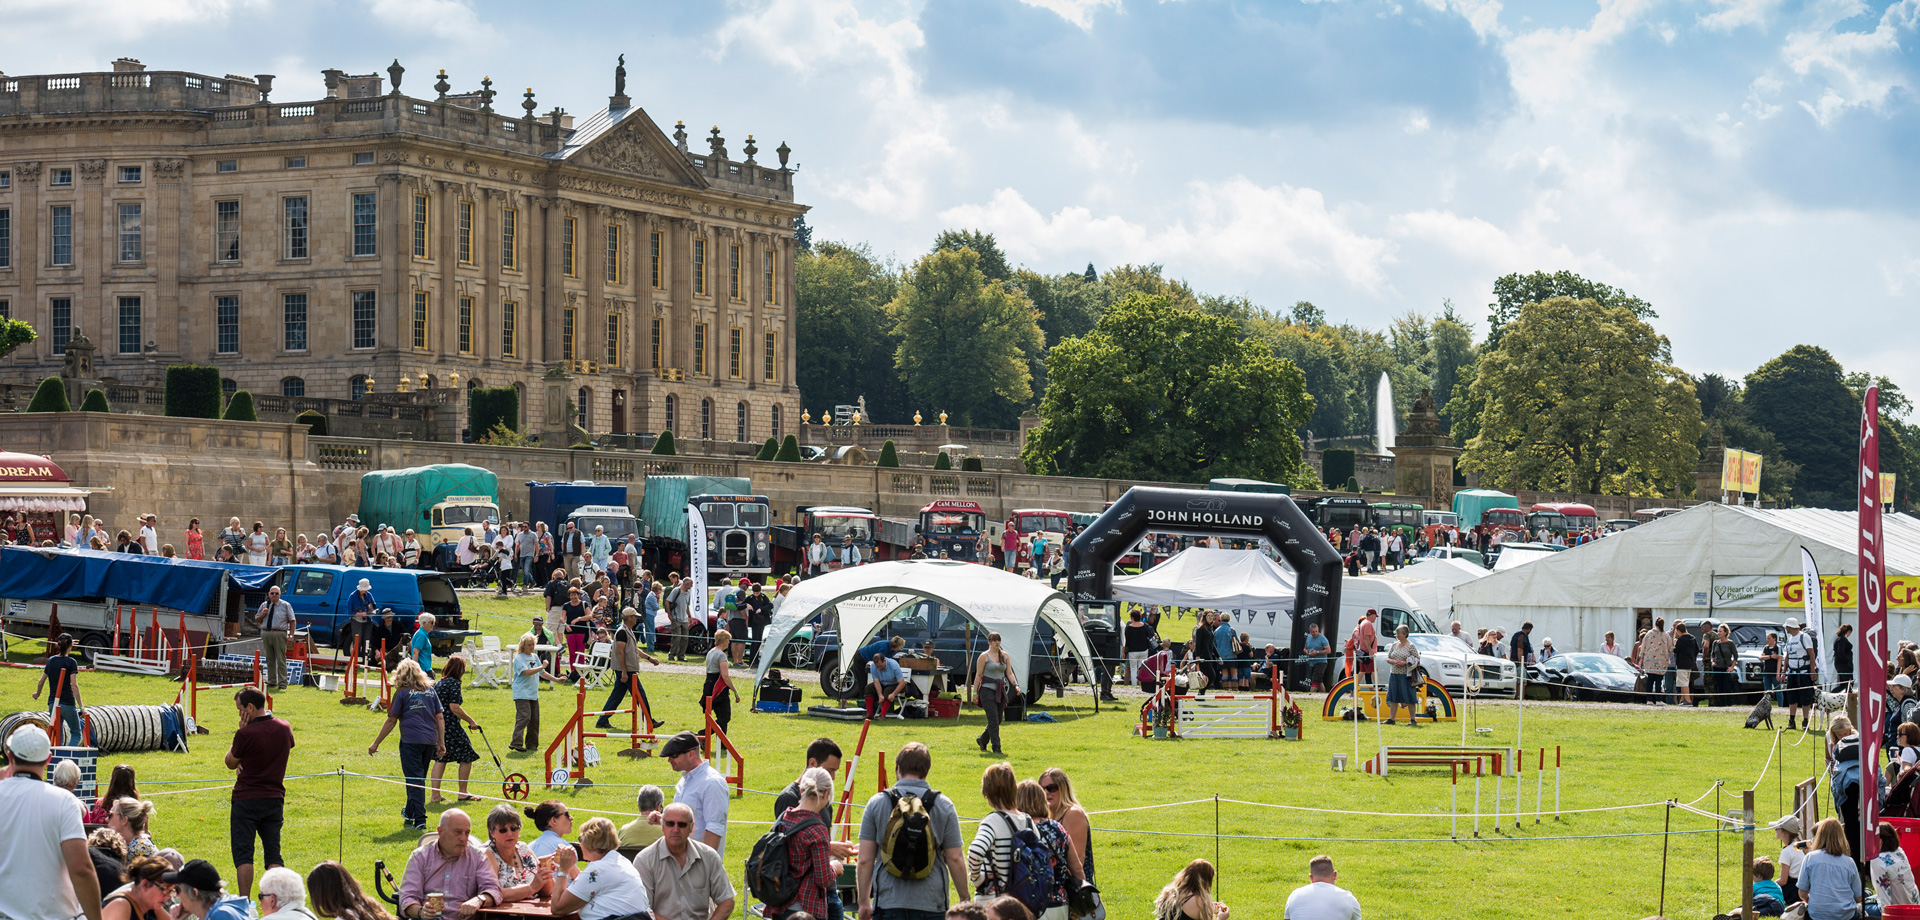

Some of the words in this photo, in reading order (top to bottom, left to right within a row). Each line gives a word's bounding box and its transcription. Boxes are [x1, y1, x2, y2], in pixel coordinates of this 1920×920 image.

[0, 467, 53, 477] DREAM
[1148, 510, 1187, 521] JOHN
[1193, 512, 1263, 526] HOLLAND
[1783, 579, 1850, 604] Gts
